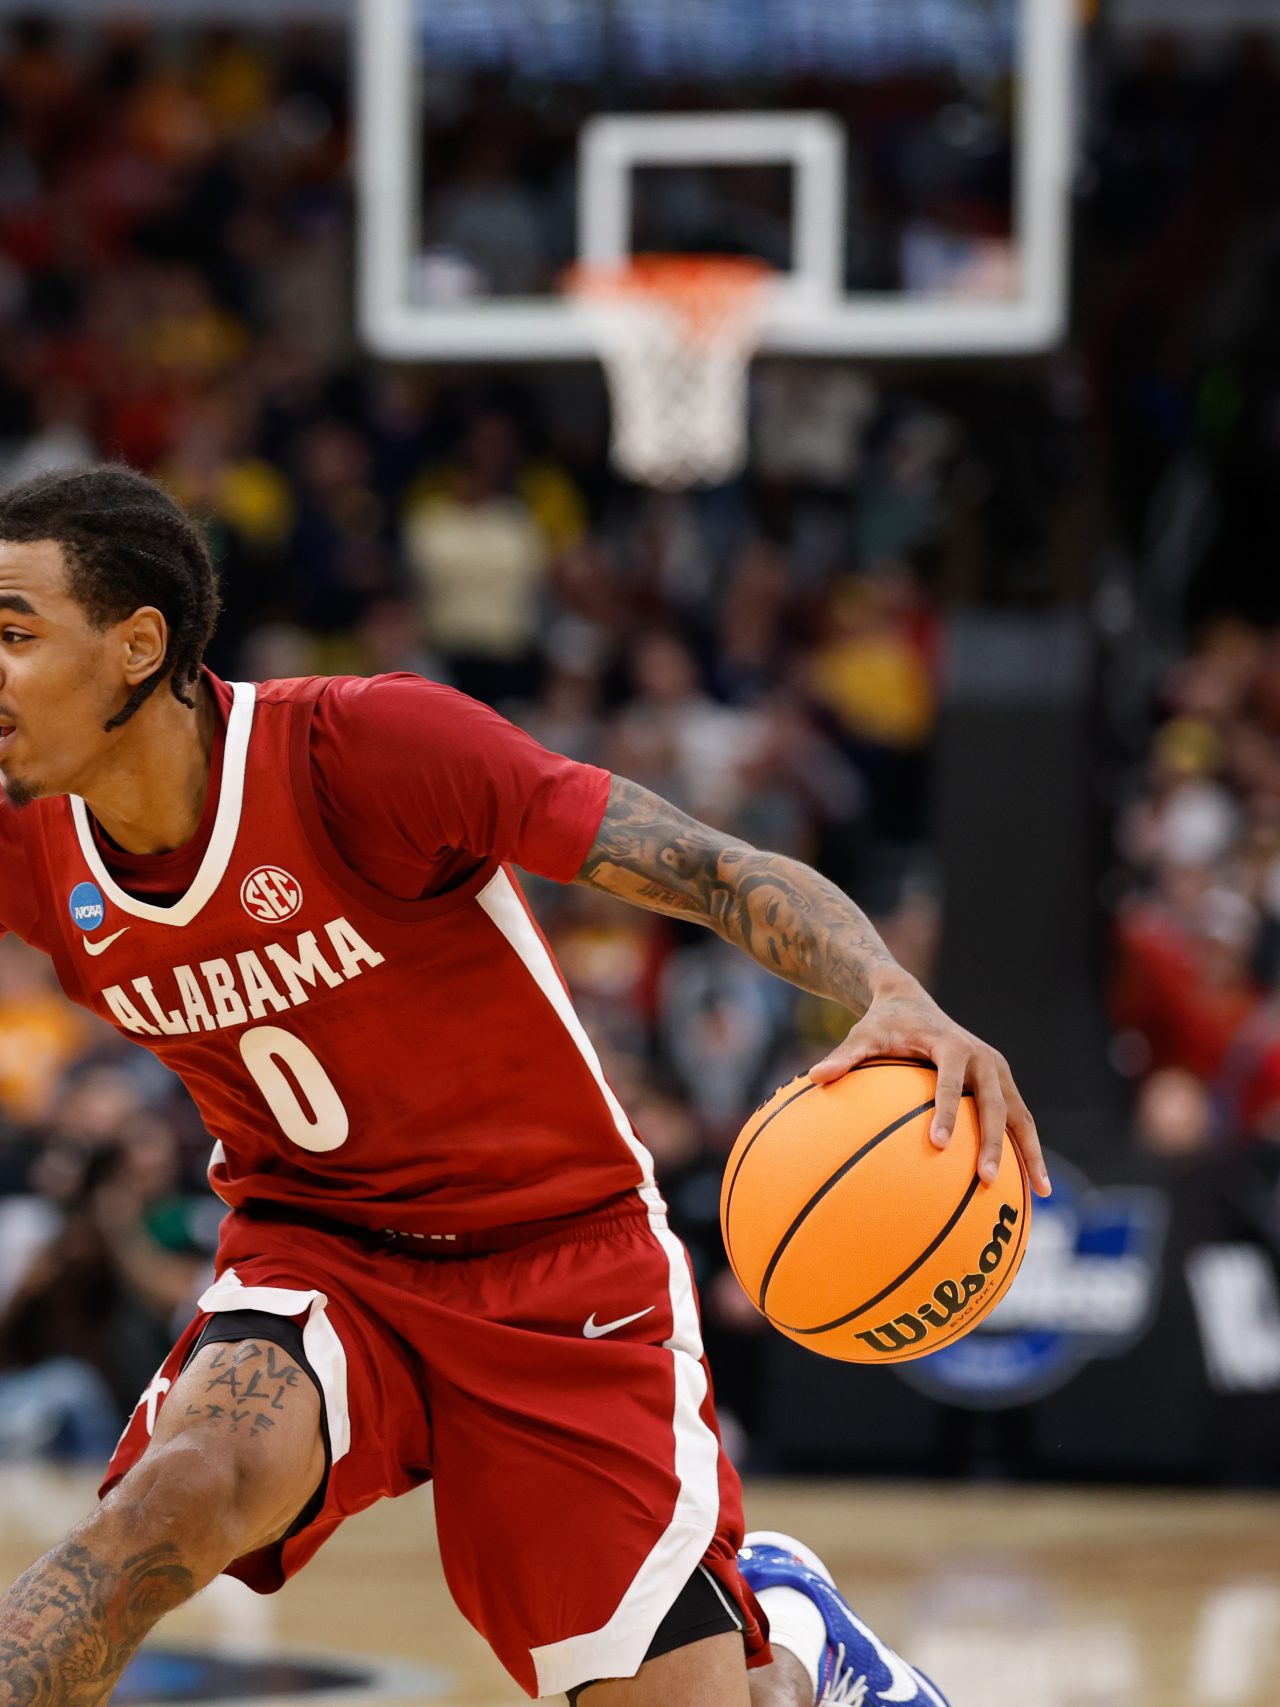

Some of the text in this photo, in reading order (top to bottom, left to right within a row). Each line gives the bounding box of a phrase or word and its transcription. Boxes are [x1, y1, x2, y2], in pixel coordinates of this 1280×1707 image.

[75, 904, 104, 920] NCAA
[245, 870, 299, 920] SEC
[101, 916, 386, 1036] ALABAMA
[239, 1025, 350, 1153] 0
[853, 1203, 1018, 1352] Wilson
[949, 1279, 996, 1328] EVO NXT
[205, 1366, 285, 1410] ALL
[208, 1342, 303, 1387] LOVE
